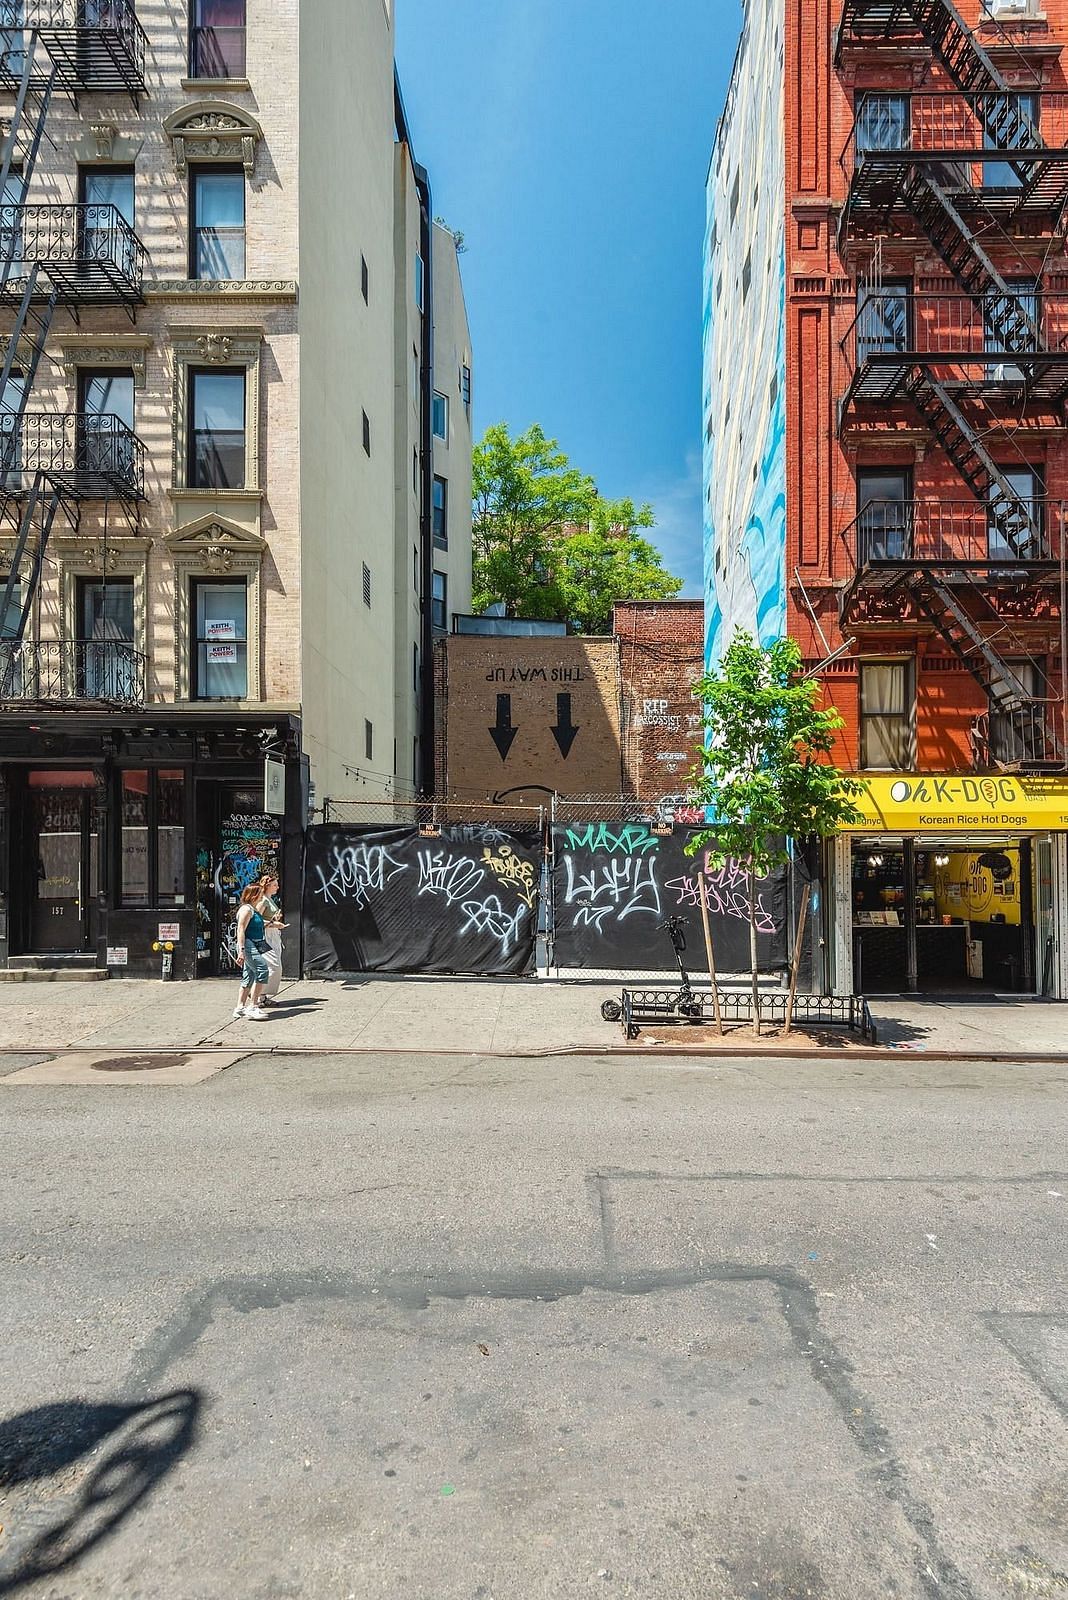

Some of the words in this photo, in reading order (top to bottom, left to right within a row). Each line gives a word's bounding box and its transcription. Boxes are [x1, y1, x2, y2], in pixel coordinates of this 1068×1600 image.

[485, 668, 506, 682] UP
[509, 668, 547, 682] WAY
[550, 668, 584, 681] THIS
[642, 699, 668, 715] RIP
[890, 779, 932, 803] Oh
[936, 778, 1016, 808] K-DOG
[919, 815, 955, 825] Korean
[957, 815, 979, 825] Rice
[981, 815, 999, 825] Hot
[1001, 815, 1028, 826] Dogs
[51, 906, 64, 915] 157
